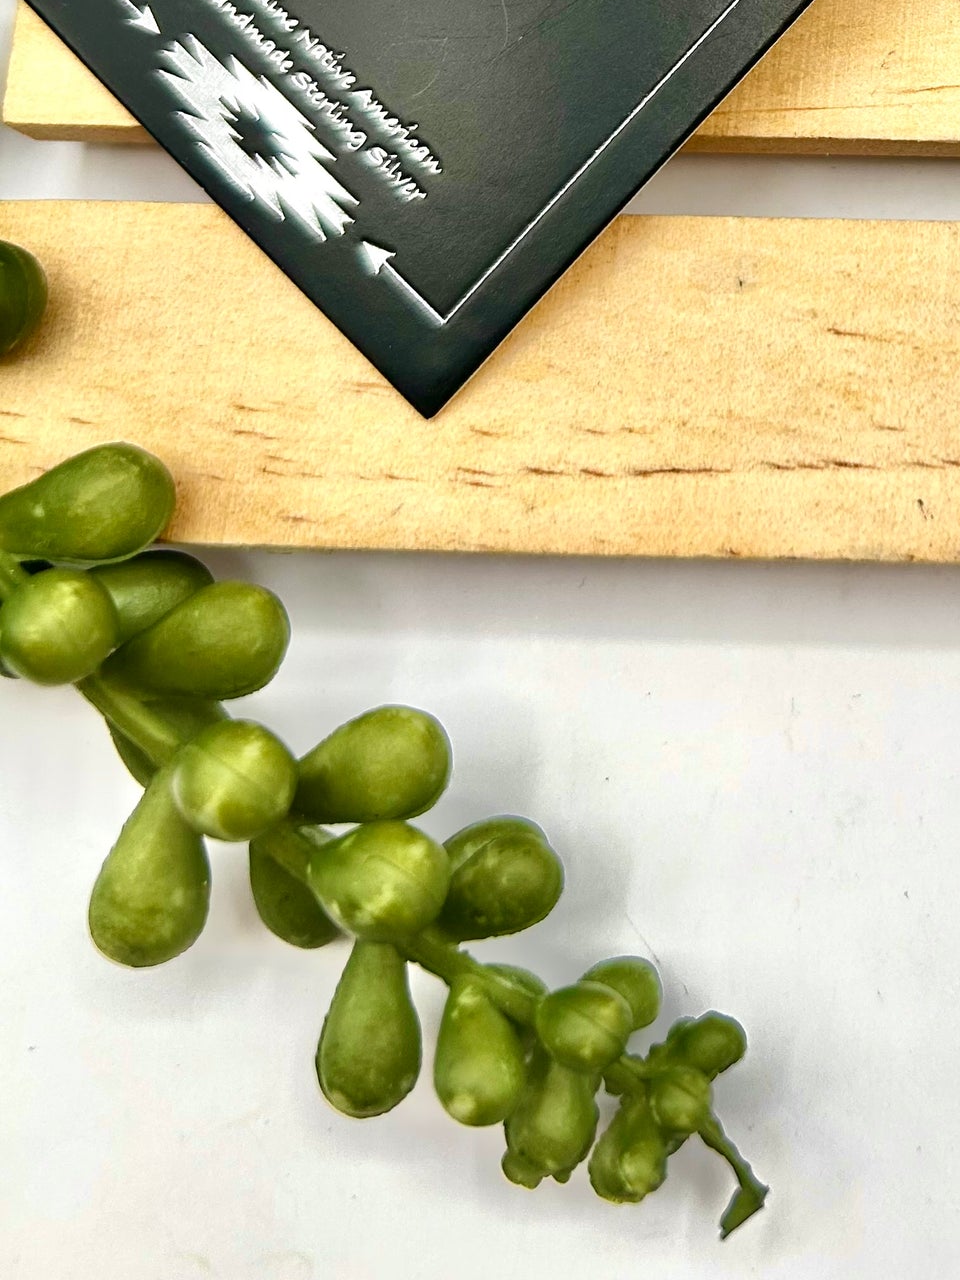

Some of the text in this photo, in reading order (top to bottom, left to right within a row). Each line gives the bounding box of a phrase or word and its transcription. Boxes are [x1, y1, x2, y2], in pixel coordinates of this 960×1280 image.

[290, 73, 368, 152] Sterling
[365, 149, 428, 203] Silver
[295, 29, 356, 90] Native
[349, 89, 443, 175] American
